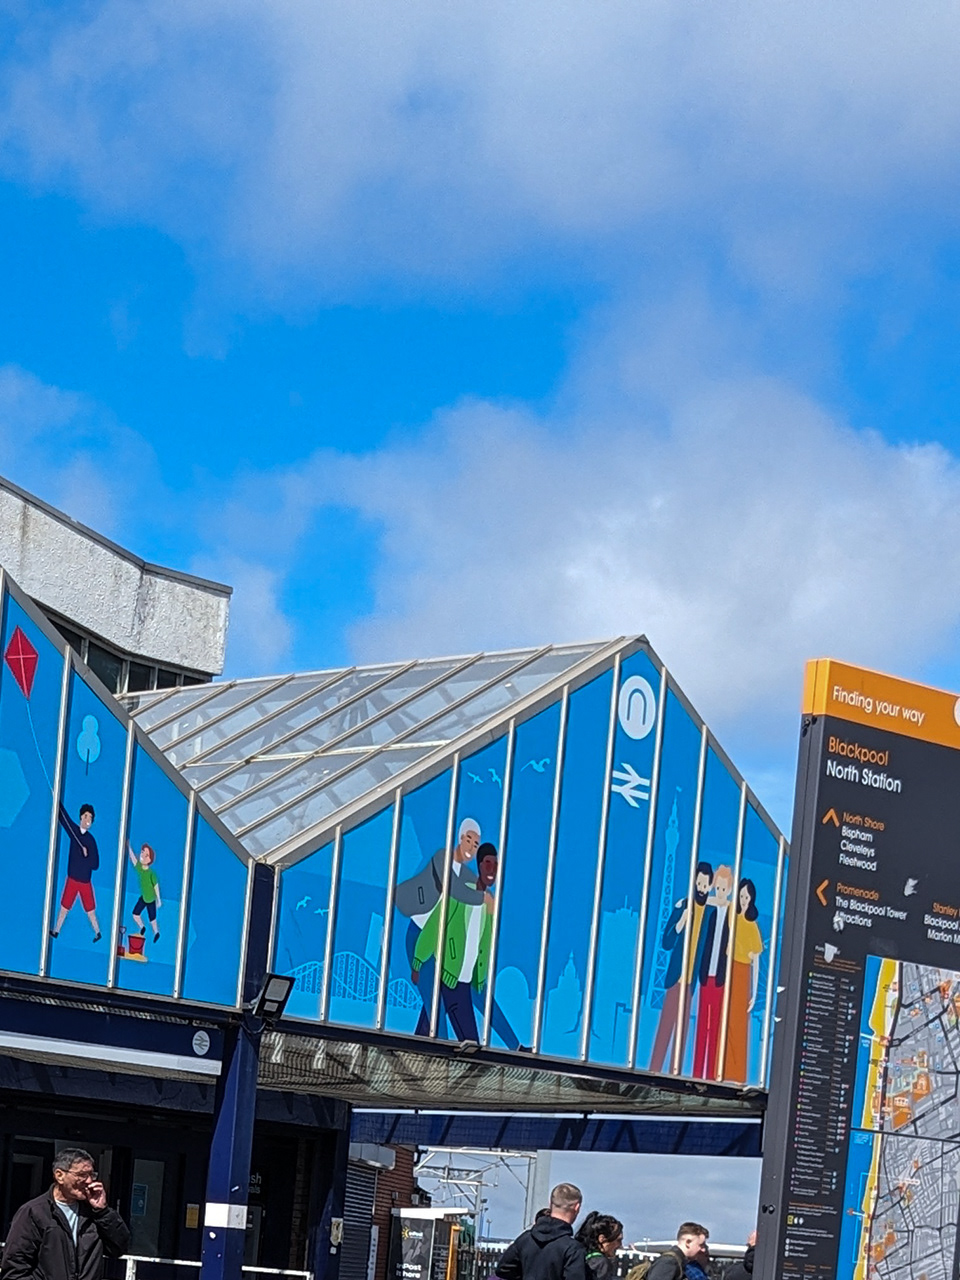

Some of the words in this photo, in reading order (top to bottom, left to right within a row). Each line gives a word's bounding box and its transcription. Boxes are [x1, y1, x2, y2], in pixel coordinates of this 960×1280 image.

[832, 685, 874, 714] Finding
[876, 699, 900, 716] your
[902, 706, 926, 727] way
[828, 736, 889, 767] Blackpool
[826, 759, 860, 783] North
[861, 767, 902, 793] Station
[842, 811, 863, 826] North
[864, 816, 885, 831] Shore
[841, 825, 874, 842] Bispham
[840, 839, 876, 858] Cleveleys
[839, 853, 877, 871] Fleetwood
[836, 882, 879, 901] Promenade
[835, 895, 849, 909] The
[849, 899, 886, 916] Blackpool
[886, 906, 908, 921] Tower
[932, 902, 958, 918] Stanley
[924, 914, 959, 932] Blackpool
[927, 928, 953, 943] Marton
[249, 1172, 262, 1185] sh
